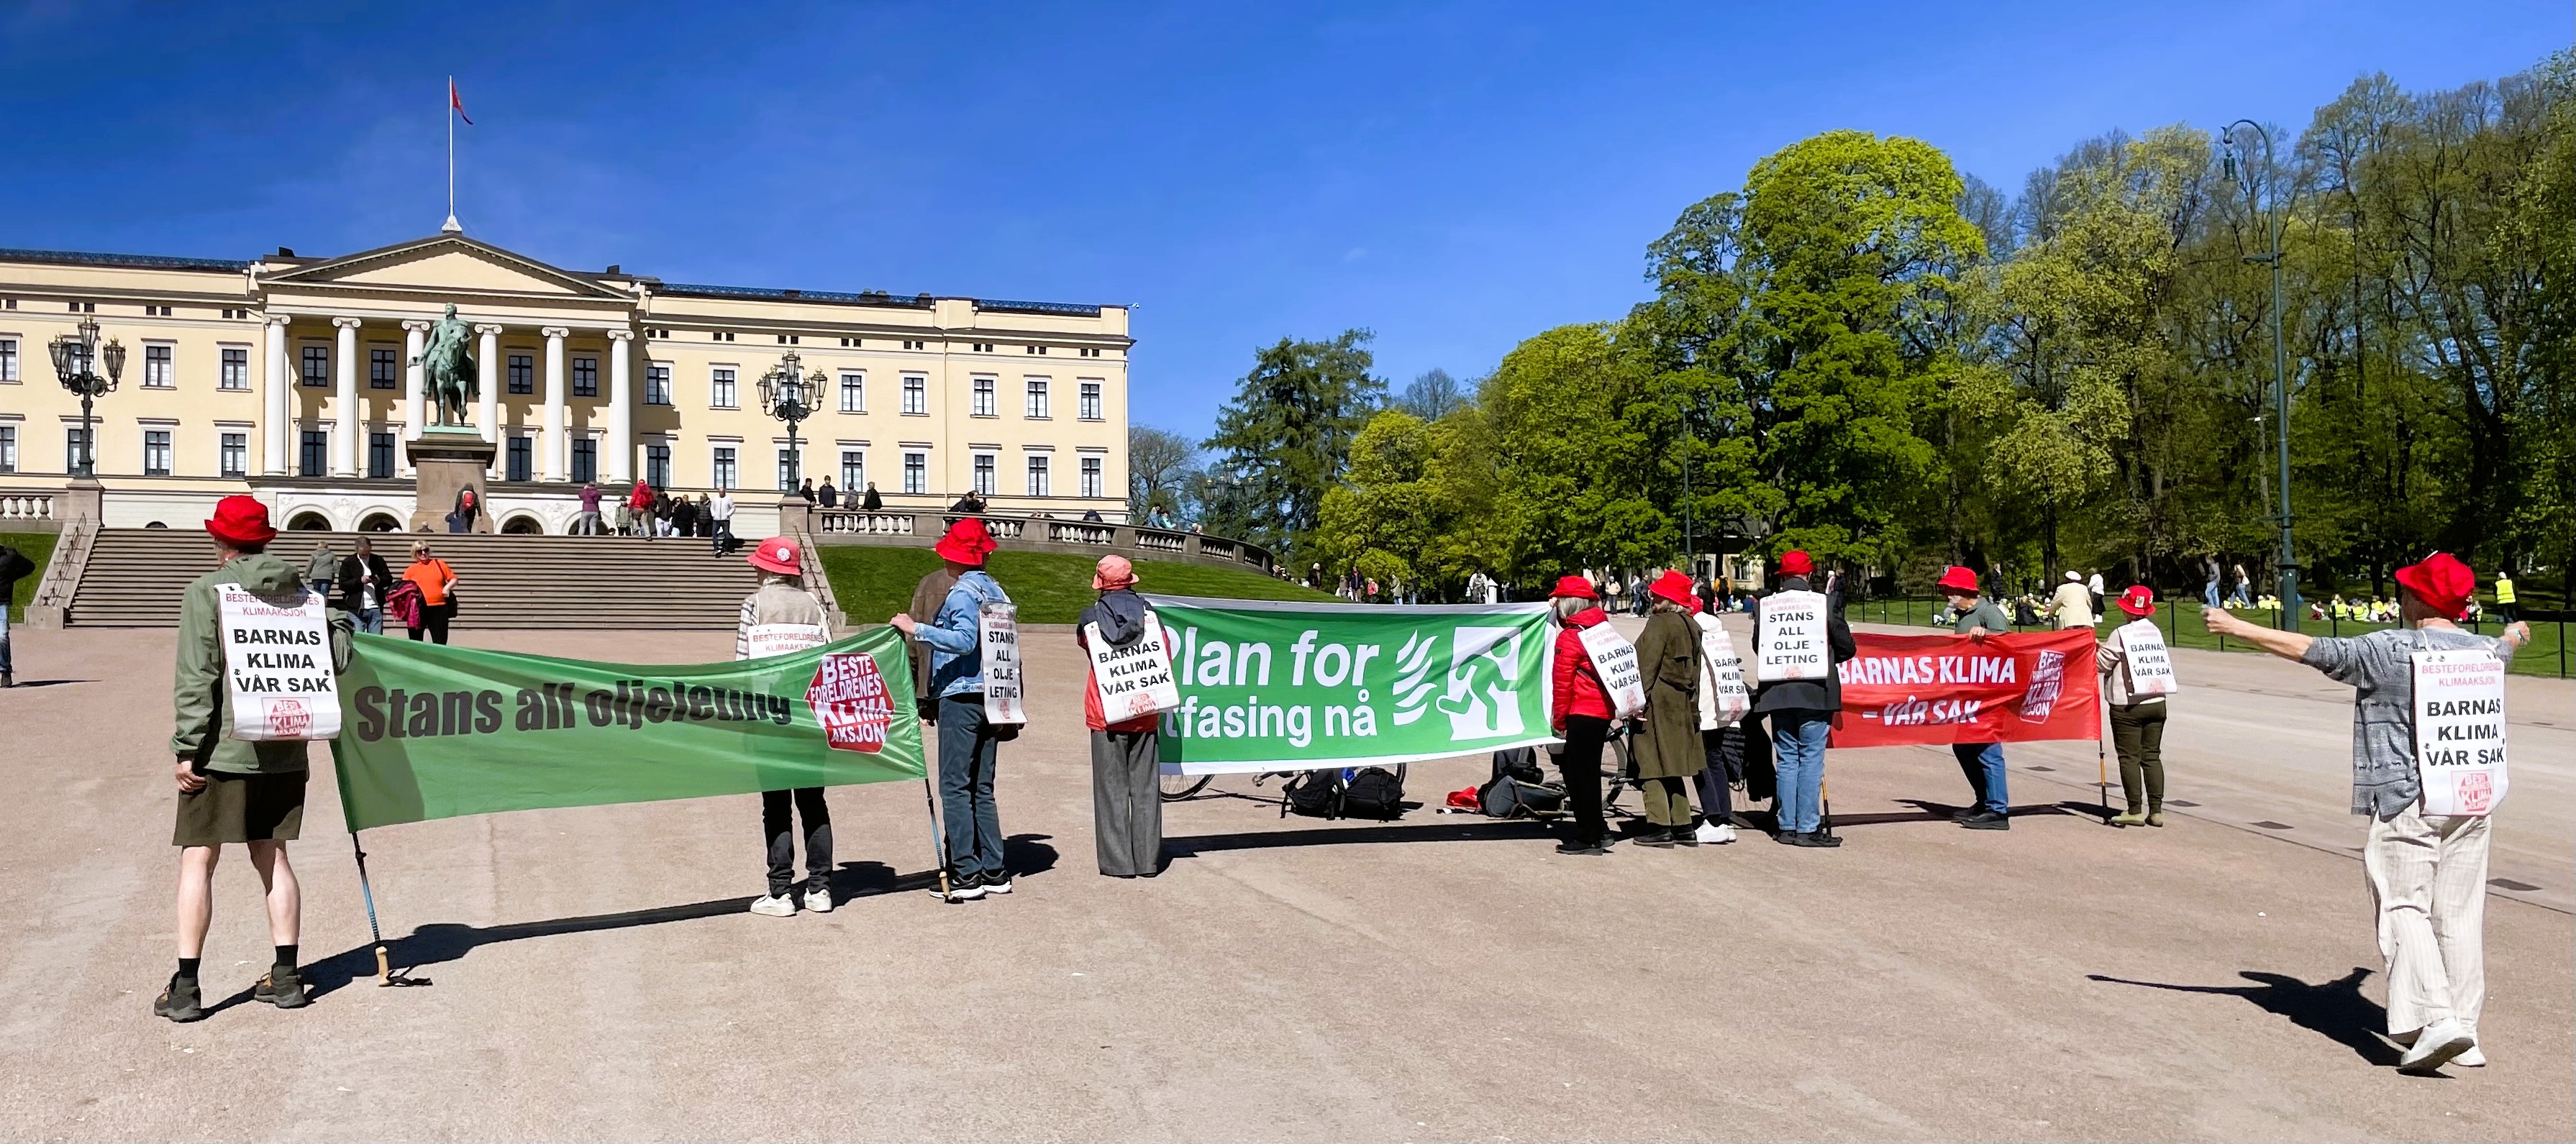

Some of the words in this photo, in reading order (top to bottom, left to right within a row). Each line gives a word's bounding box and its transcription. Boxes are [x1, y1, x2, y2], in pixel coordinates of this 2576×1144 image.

[242, 606, 306, 618] KLIMAAKSJON
[1769, 611, 1813, 623] STANS
[233, 628, 321, 646] BARNAS
[988, 631, 1014, 644] STANS
[1778, 626, 1804, 636] ALL
[1098, 641, 1160, 664] BARNAS
[1597, 644, 1634, 664] BARNAS
[1774, 640, 1810, 651] OLJE
[2130, 643, 2165, 652] BARNAS
[247, 653, 316, 669] KLIMA
[996, 649, 1011, 662] ALL
[1290, 629, 1380, 688] for
[1766, 654, 1818, 665] LETING
[2138, 655, 2165, 664] KLIMA
[821, 655, 873, 685] BESTE
[993, 667, 1014, 680] OLJE
[1109, 658, 1158, 678] KLIMA
[1610, 659, 1636, 675] KLIMA
[1837, 656, 1936, 685] BARNAS
[1939, 656, 2016, 684] KLIMA
[2155, 667, 2172, 676] SAK
[235, 674, 282, 692] VÅR
[287, 677, 332, 692] SAK
[810, 672, 883, 705] FORELDRENES
[989, 685, 1018, 698] LETING
[1101, 680, 1136, 695] VÅR
[1139, 672, 1170, 688] SAK
[354, 685, 504, 742] Stans
[516, 682, 575, 731] all
[1324, 688, 1378, 738] nå
[1883, 695, 1930, 726] VÅR
[1930, 700, 1983, 726] SAK
[2427, 697, 2501, 717] BARNAS
[831, 721, 887, 743] AKSJON
[2438, 723, 2498, 741] KLIMA
[2425, 746, 2470, 767] VÅR
[2477, 746, 2504, 765] SAK
